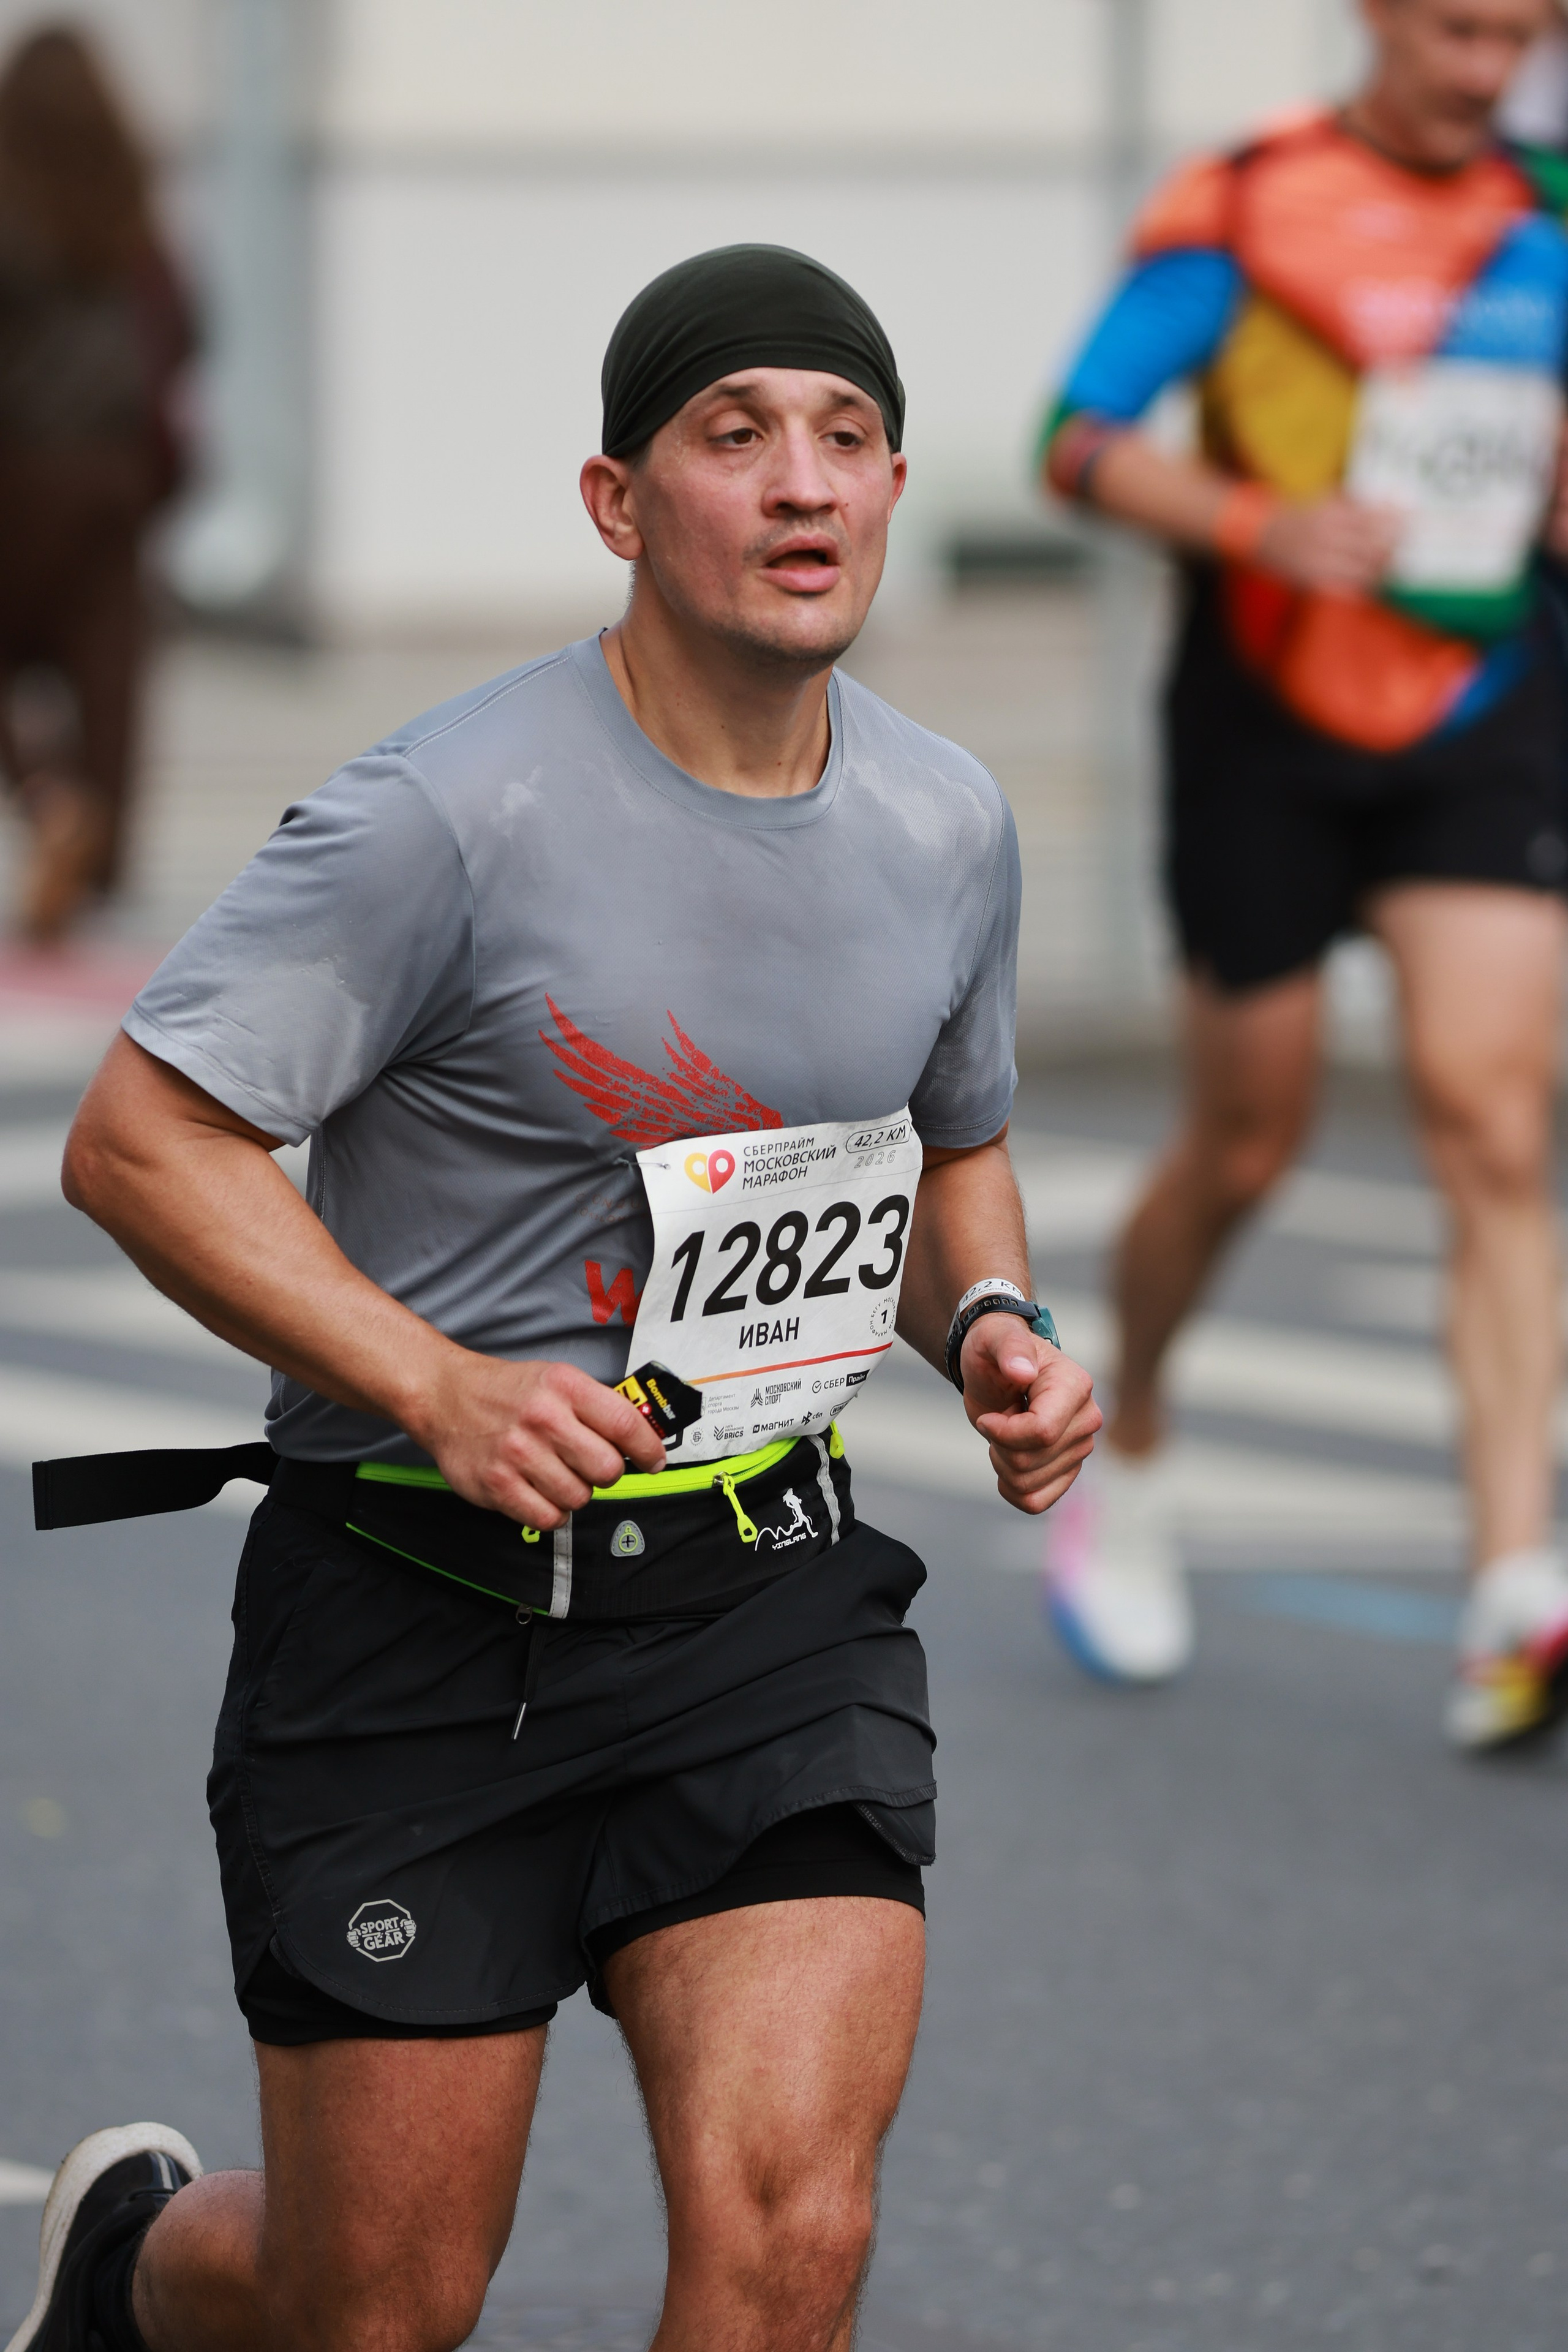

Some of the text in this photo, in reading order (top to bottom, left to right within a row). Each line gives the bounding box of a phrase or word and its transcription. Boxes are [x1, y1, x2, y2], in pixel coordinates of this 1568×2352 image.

[854, 1125, 906, 1148] 42,2 КМ
[743, 1137, 815, 1157] СБЕРПРАЙМ
[744, 1144, 837, 1174] МОСКОВСКИЙ
[854, 1150, 896, 1169] 2026
[742, 1166, 809, 1189] МАРАФОН
[670, 1194, 910, 1322] 12823
[962, 1281, 993, 1304] 42,2
[870, 1302, 881, 1317] БЕГУ
[881, 1309, 888, 1324] 1
[739, 1316, 800, 1349] ИВАН
[869, 1320, 888, 1337] МАРАФОН
[765, 1378, 802, 1395] МОСКОВСКИЙ
[823, 1377, 845, 1389] СБЕР
[646, 1378, 676, 1420] Bombbar
[709, 1393, 736, 1402] Департамент
[764, 1393, 782, 1406] СПОРТ
[724, 1430, 744, 1439] BRICS
[772, 1532, 807, 1550] YINGLANG
[360, 1916, 399, 1934] SPORT
[363, 1932, 405, 1950] GEAR
